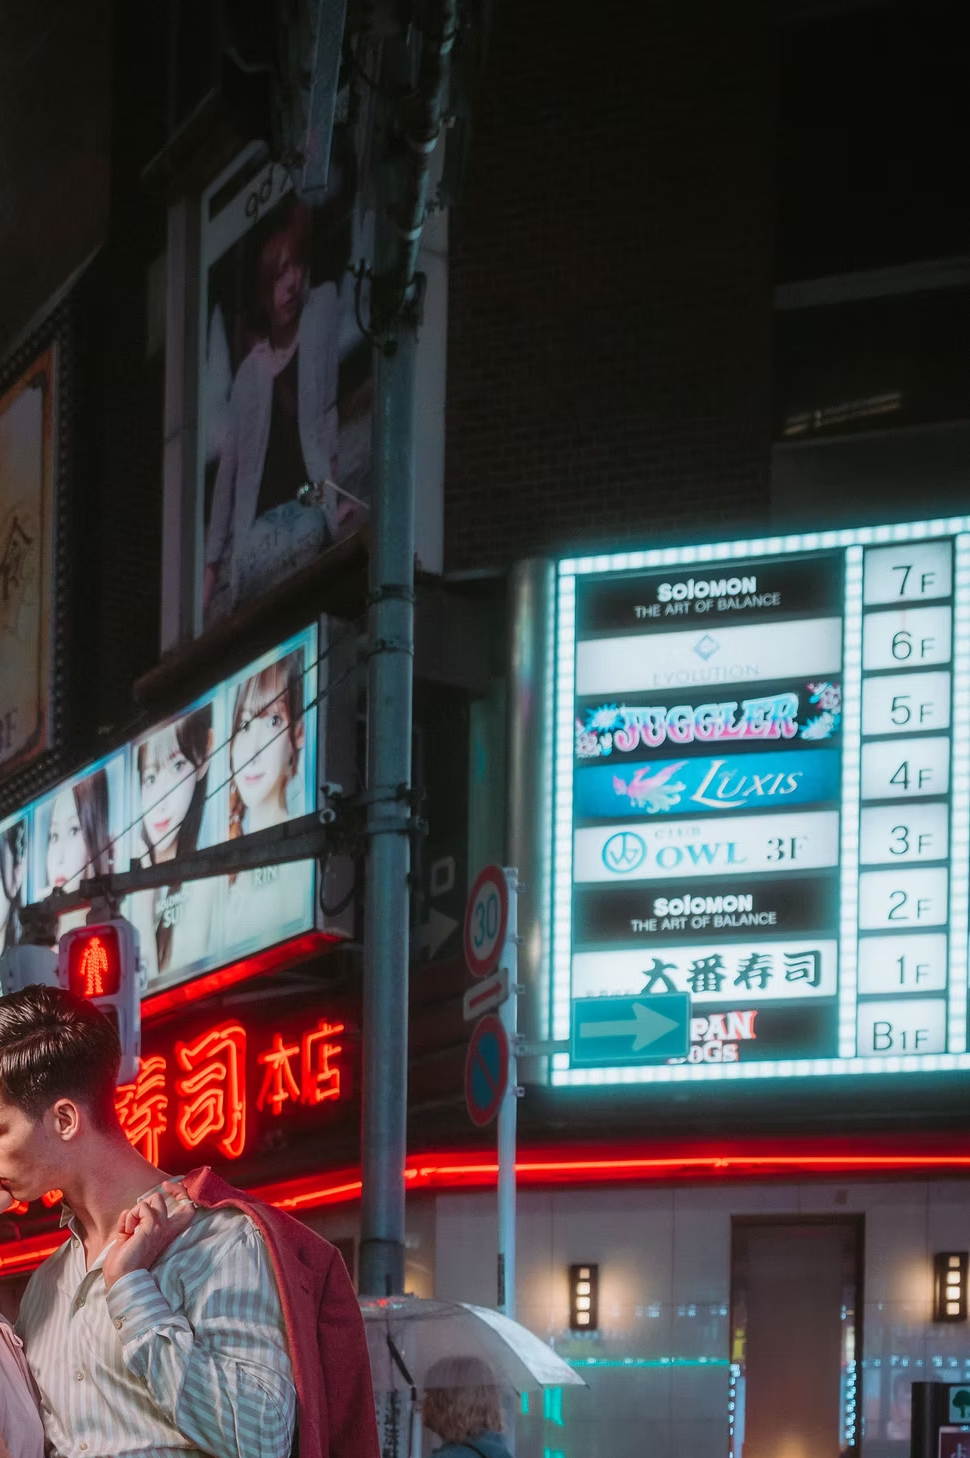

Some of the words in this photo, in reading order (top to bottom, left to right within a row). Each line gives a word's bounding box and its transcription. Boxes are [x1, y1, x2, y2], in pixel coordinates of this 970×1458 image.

[892, 565, 936, 595] 7F
[634, 604, 662, 618] THE
[665, 601, 690, 616] ART
[694, 599, 714, 613] OF
[717, 592, 781, 611] BALANCE
[891, 631, 935, 660] 6F
[653, 665, 759, 687] EVOLUTION
[614, 693, 799, 751] JUGGLER
[891, 695, 934, 724] 5F
[889, 761, 933, 790] 4F
[655, 842, 748, 869] OWL
[767, 836, 807, 862] 3F
[889, 825, 933, 855] 3F
[888, 891, 932, 920] 2F
[474, 892, 498, 949] 30
[631, 919, 657, 932] THE
[661, 917, 687, 930] ART
[691, 916, 710, 929] OF
[714, 912, 777, 928] BALANCE
[640, 950, 822, 994] 大番寿司
[896, 955, 930, 984] 1F
[872, 1021, 929, 1051] B1F
